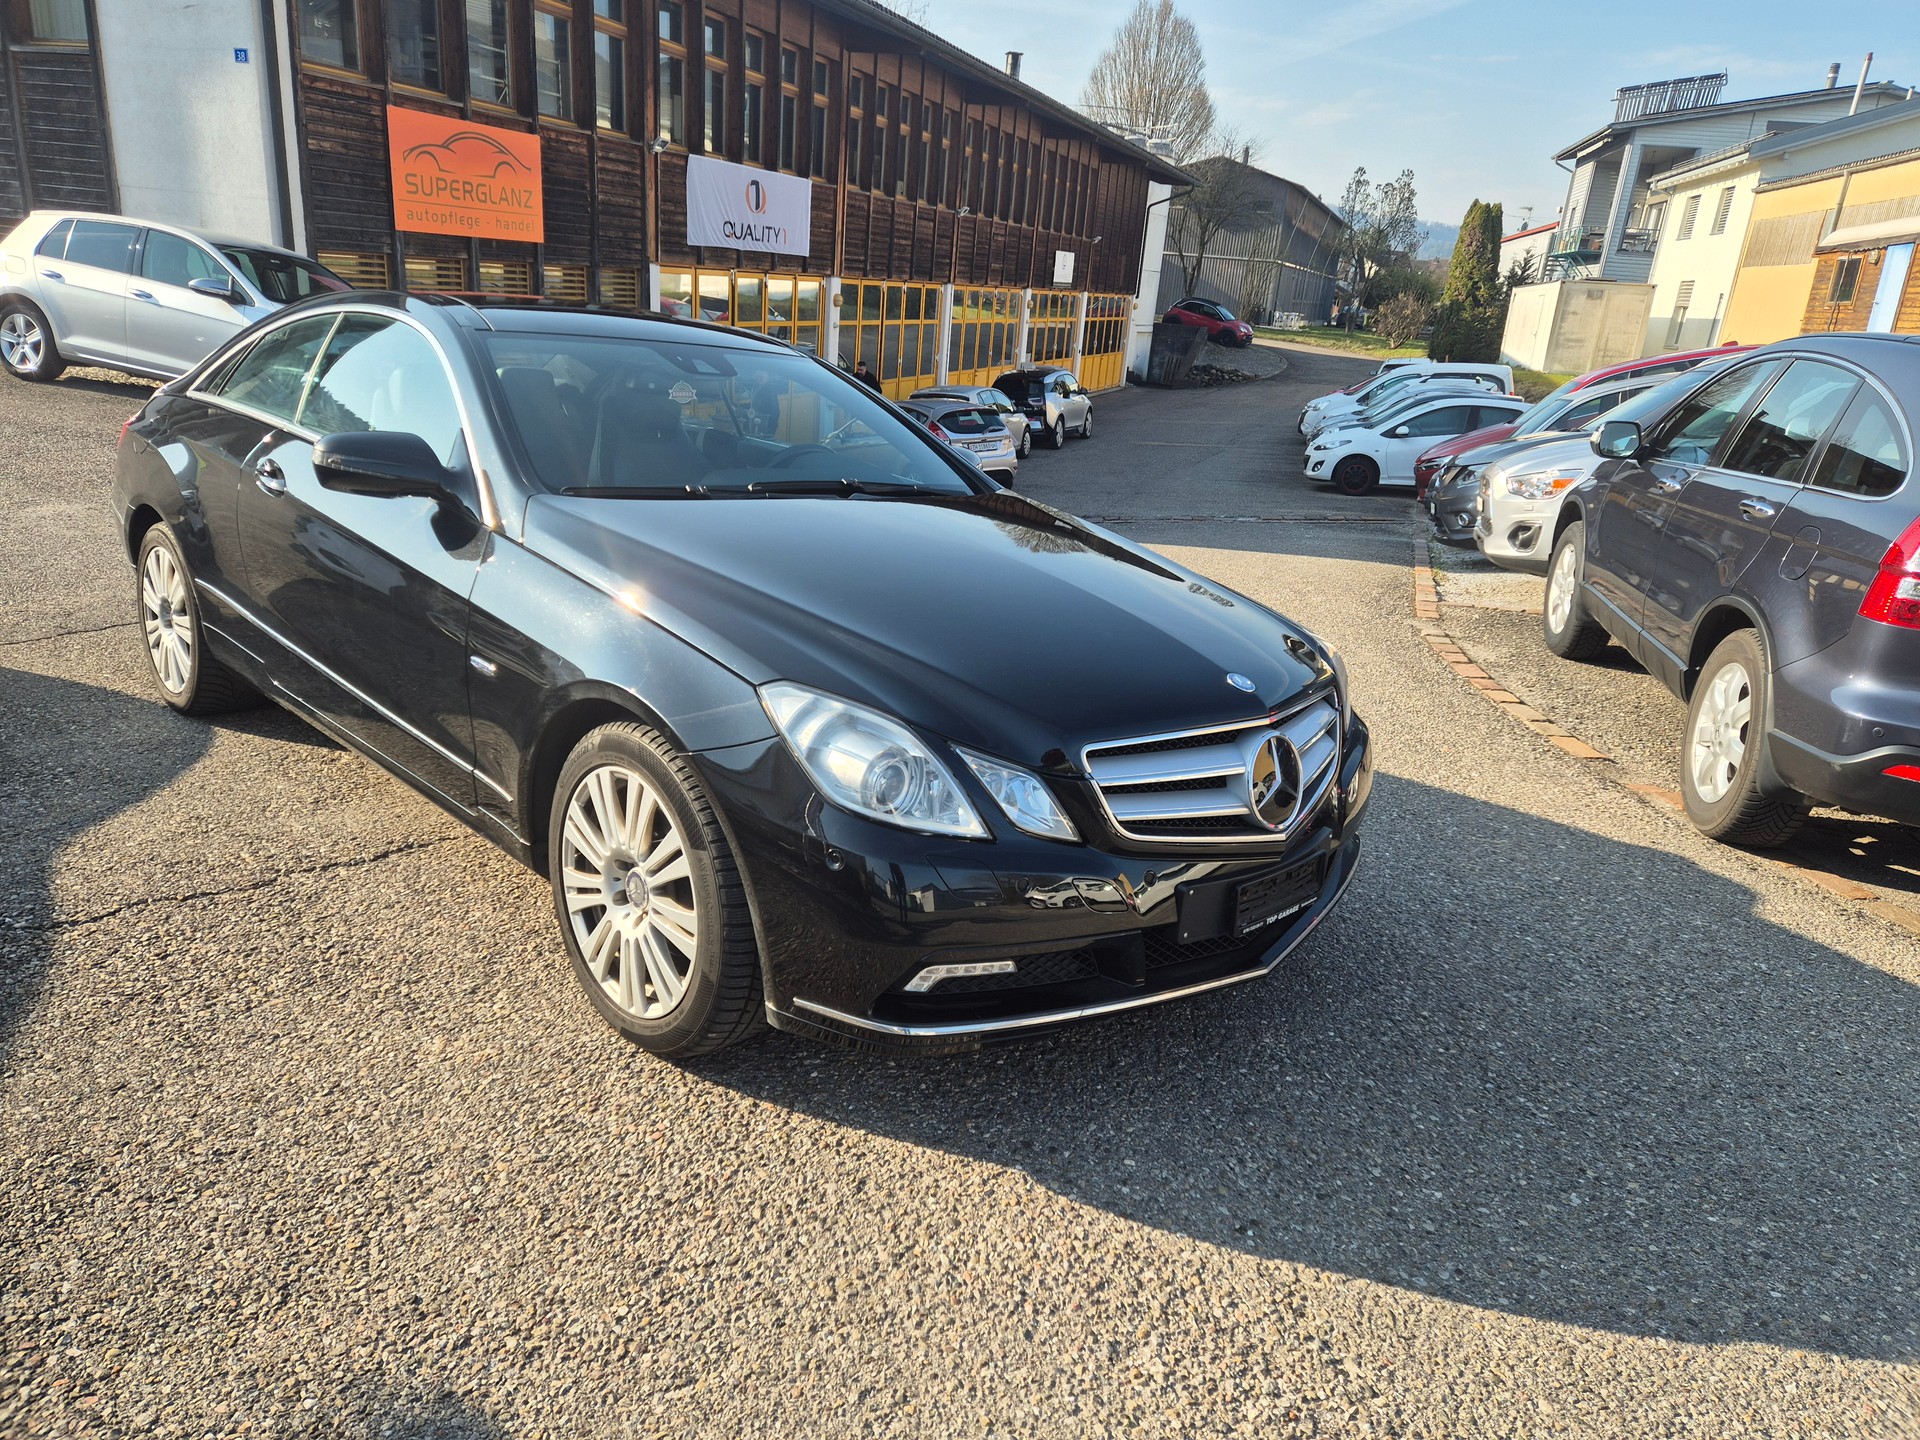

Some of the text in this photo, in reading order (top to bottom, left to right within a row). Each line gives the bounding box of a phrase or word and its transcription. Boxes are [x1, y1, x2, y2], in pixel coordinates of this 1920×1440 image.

[236, 51, 246, 61] 38
[404, 172, 534, 209] SUPERGLANZ
[406, 208, 480, 230] autopflege
[495, 216, 536, 233] handel
[1266, 904, 1300, 925] TOP GARAGE
